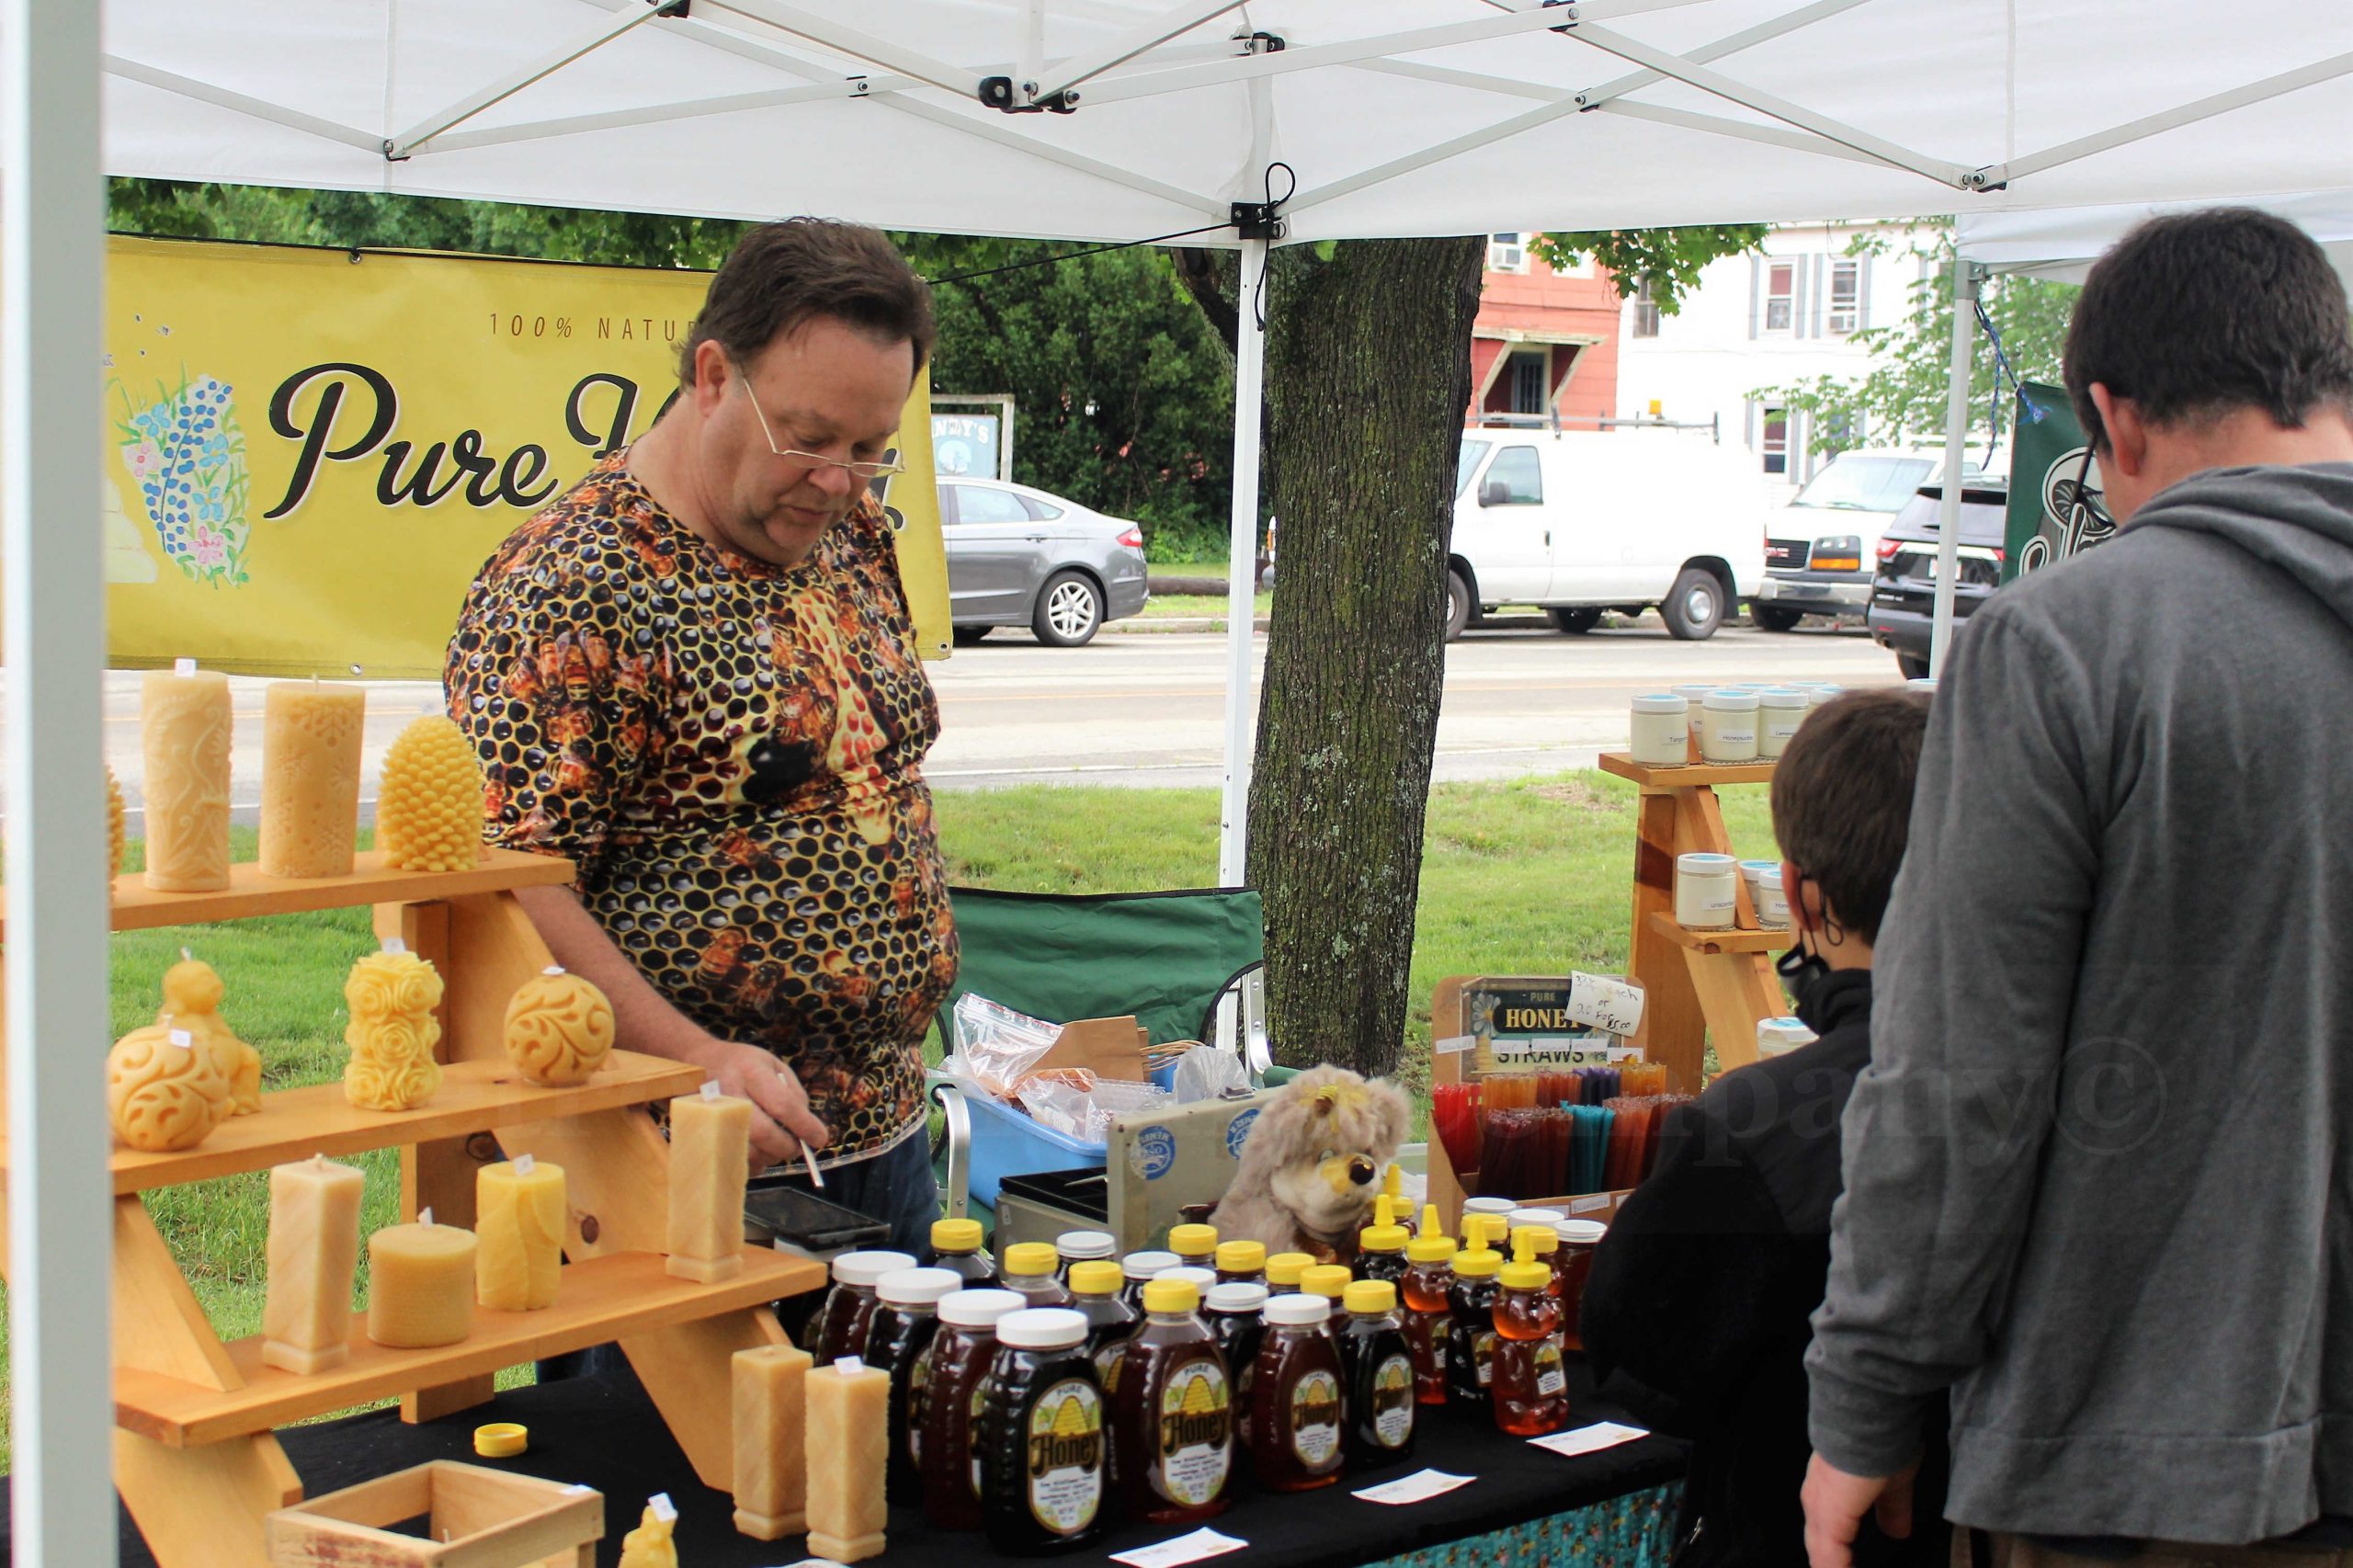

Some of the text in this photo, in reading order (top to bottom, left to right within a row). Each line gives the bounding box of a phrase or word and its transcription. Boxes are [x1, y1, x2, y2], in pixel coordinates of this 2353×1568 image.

[489, 312, 572, 339] 100%
[263, 361, 559, 521] Pure
[1529, 991, 1556, 1002] PURE
[1056, 1383, 1083, 1397] PURE
[1162, 1410, 1227, 1456] Honey
[1030, 1432, 1100, 1478] Honey
